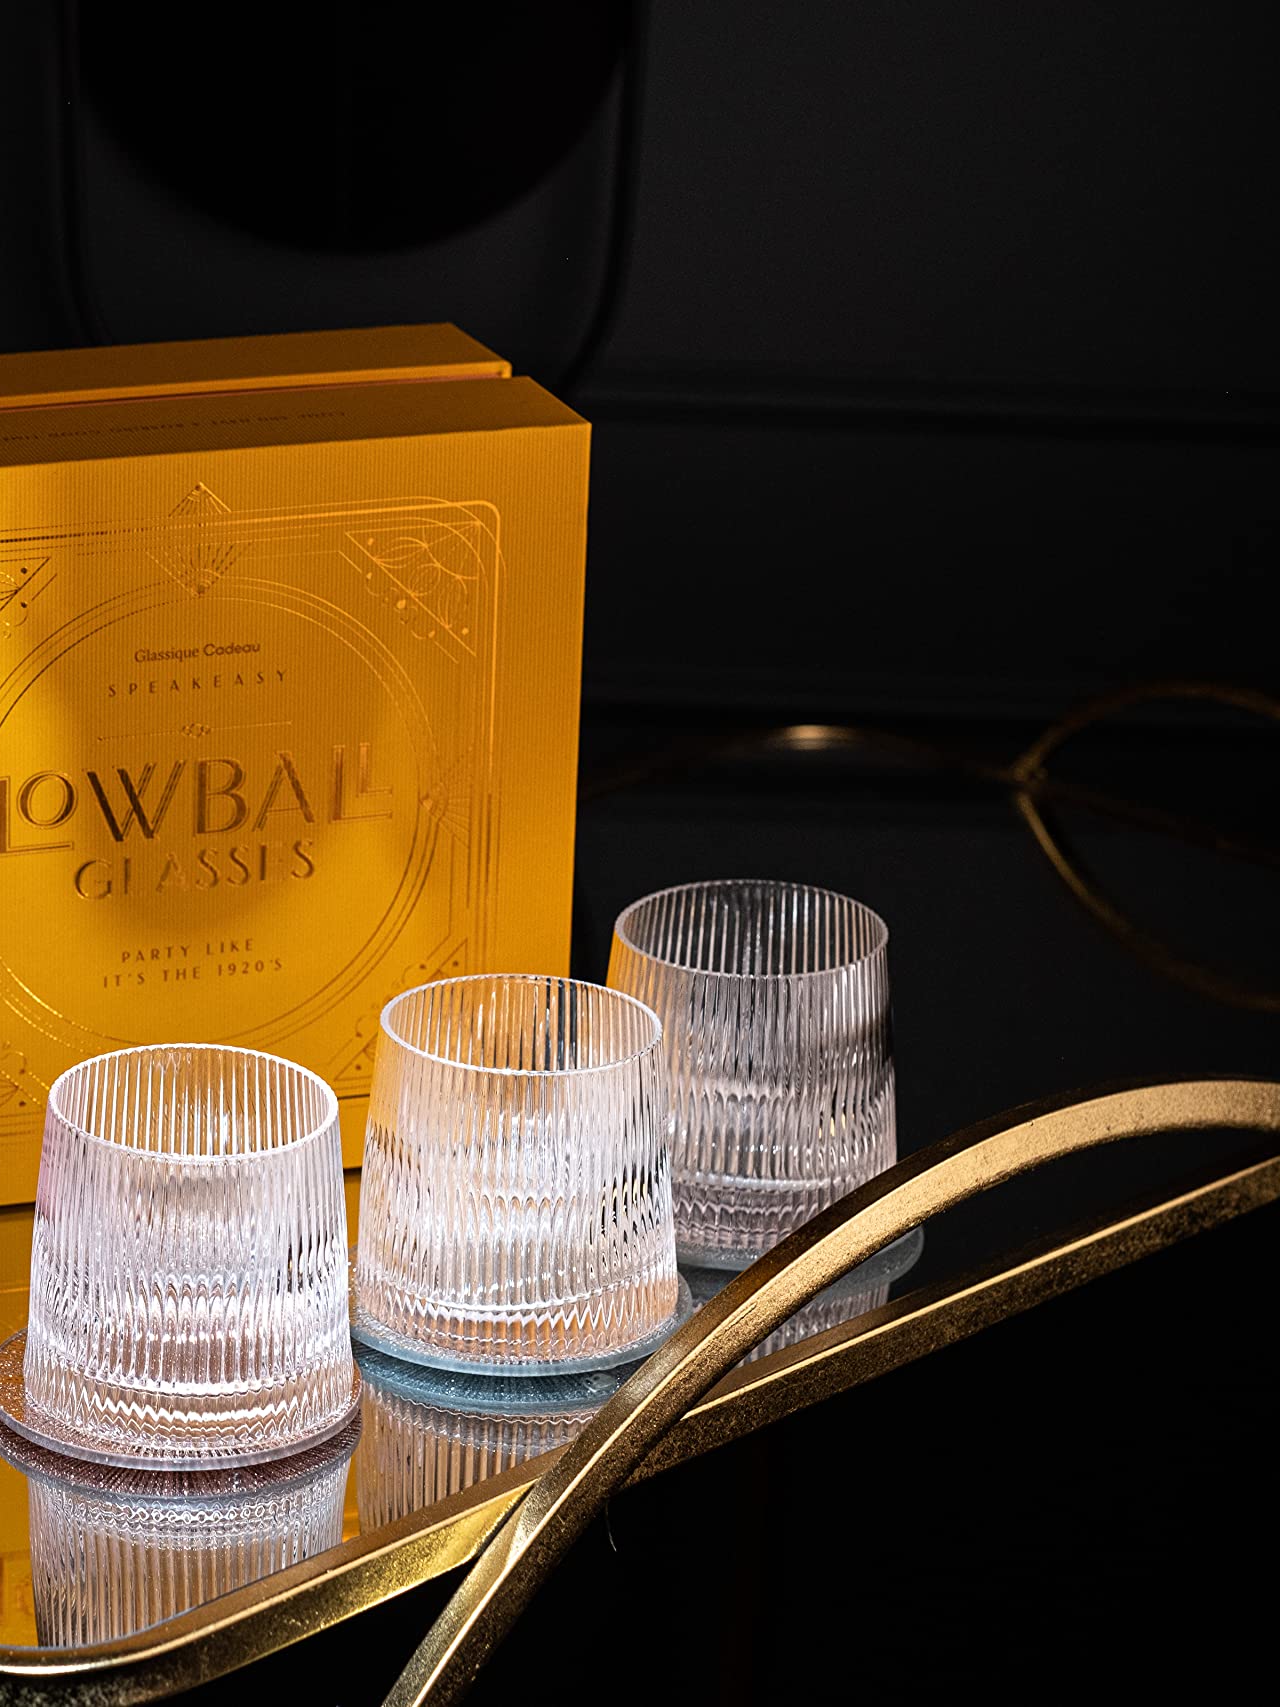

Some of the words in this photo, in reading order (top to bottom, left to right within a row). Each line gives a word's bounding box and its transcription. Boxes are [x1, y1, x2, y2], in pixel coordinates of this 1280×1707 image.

[134, 646, 199, 663] Glassique
[202, 642, 262, 657] Cadeau
[108, 669, 287, 698] SPEAKEASY
[121, 945, 189, 963] PARTY
[205, 938, 254, 956] LIKE
[102, 971, 146, 989] IT'S
[162, 965, 201, 983] THE
[217, 957, 283, 977] 1920'S
